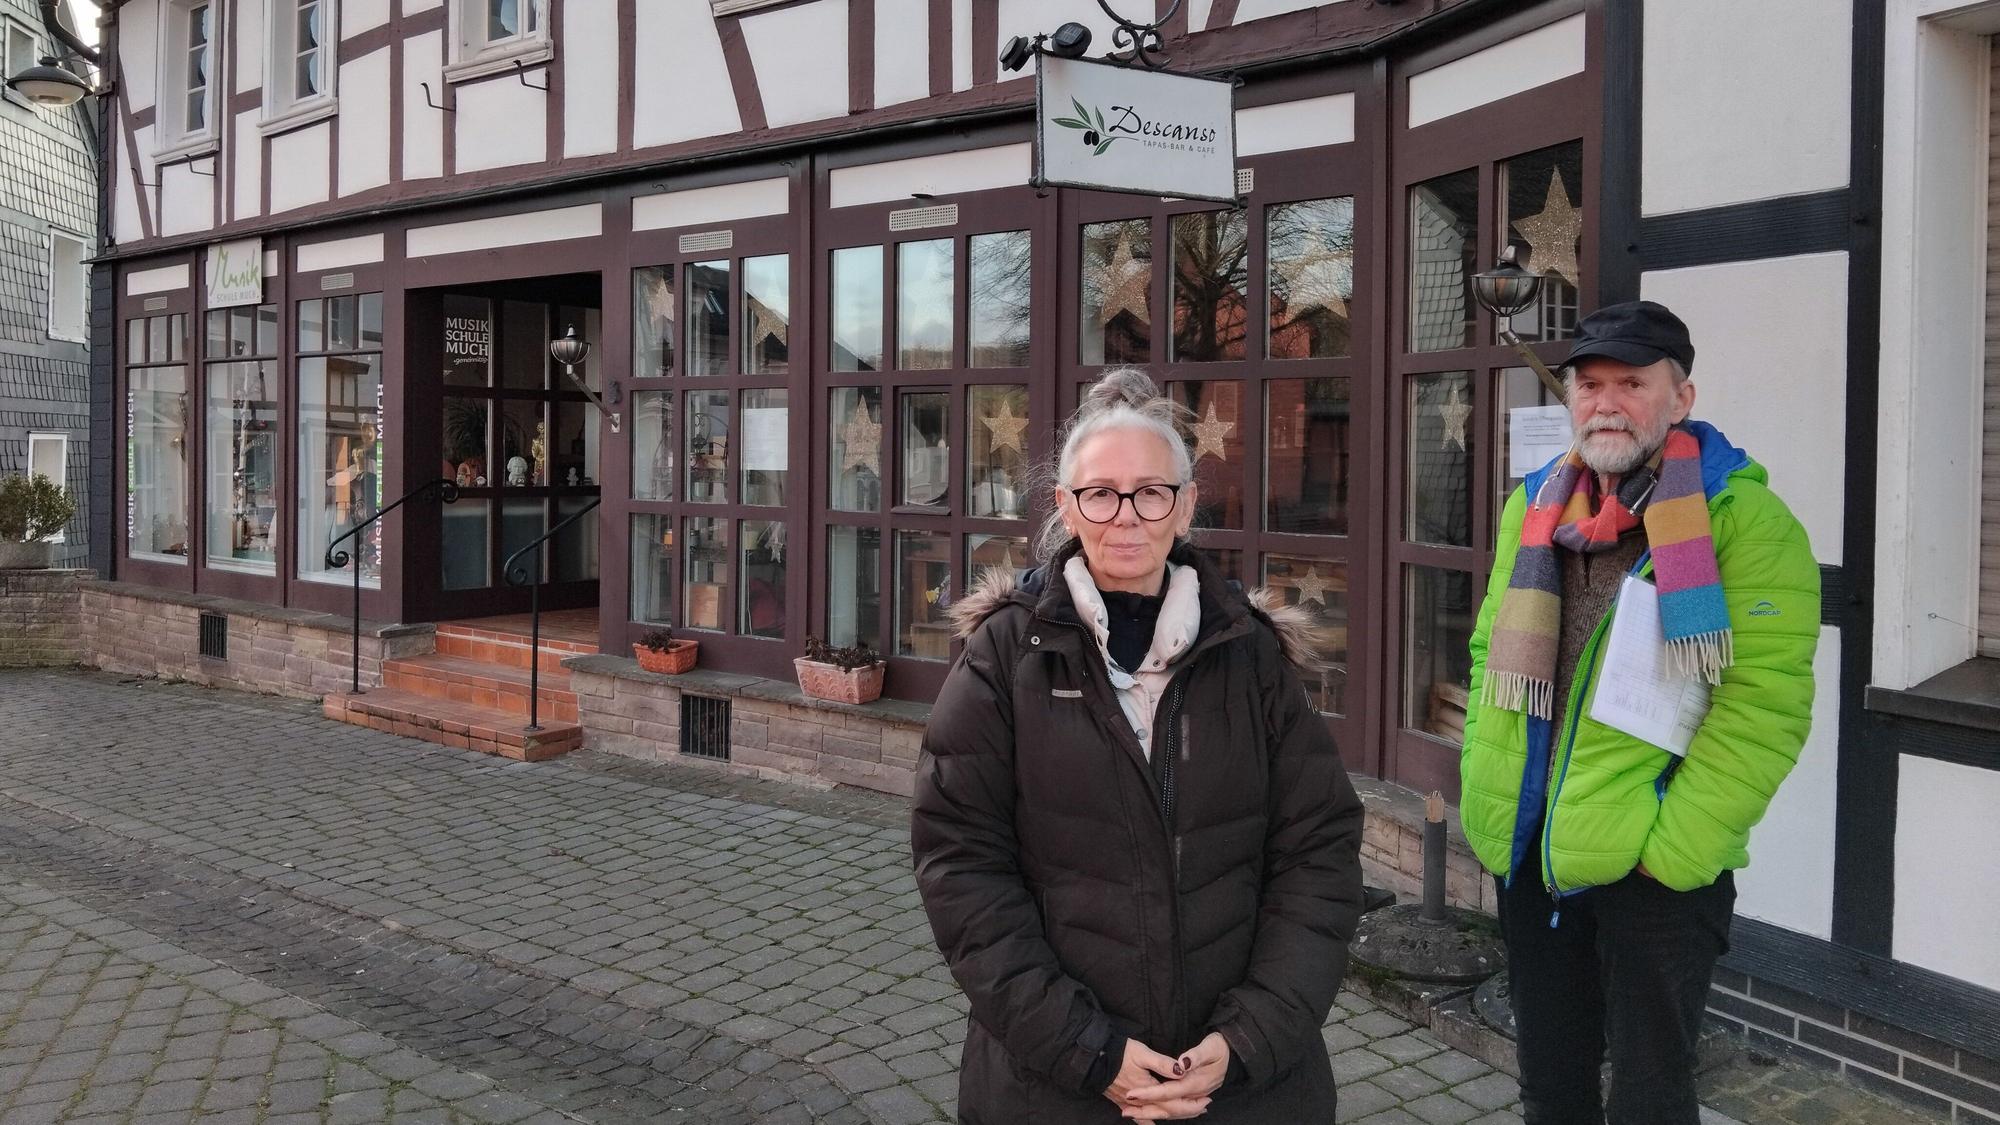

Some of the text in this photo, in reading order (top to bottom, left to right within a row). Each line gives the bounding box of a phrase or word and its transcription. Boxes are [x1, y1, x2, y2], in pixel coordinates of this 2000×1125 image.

[1109, 106, 1216, 142] Descanso
[1143, 139, 1185, 151] TAPAS-BAR
[209, 245, 261, 296] Musik
[446, 316, 488, 332] MUSIK
[446, 329, 489, 343] SCHULE
[446, 341, 488, 356] MUCH
